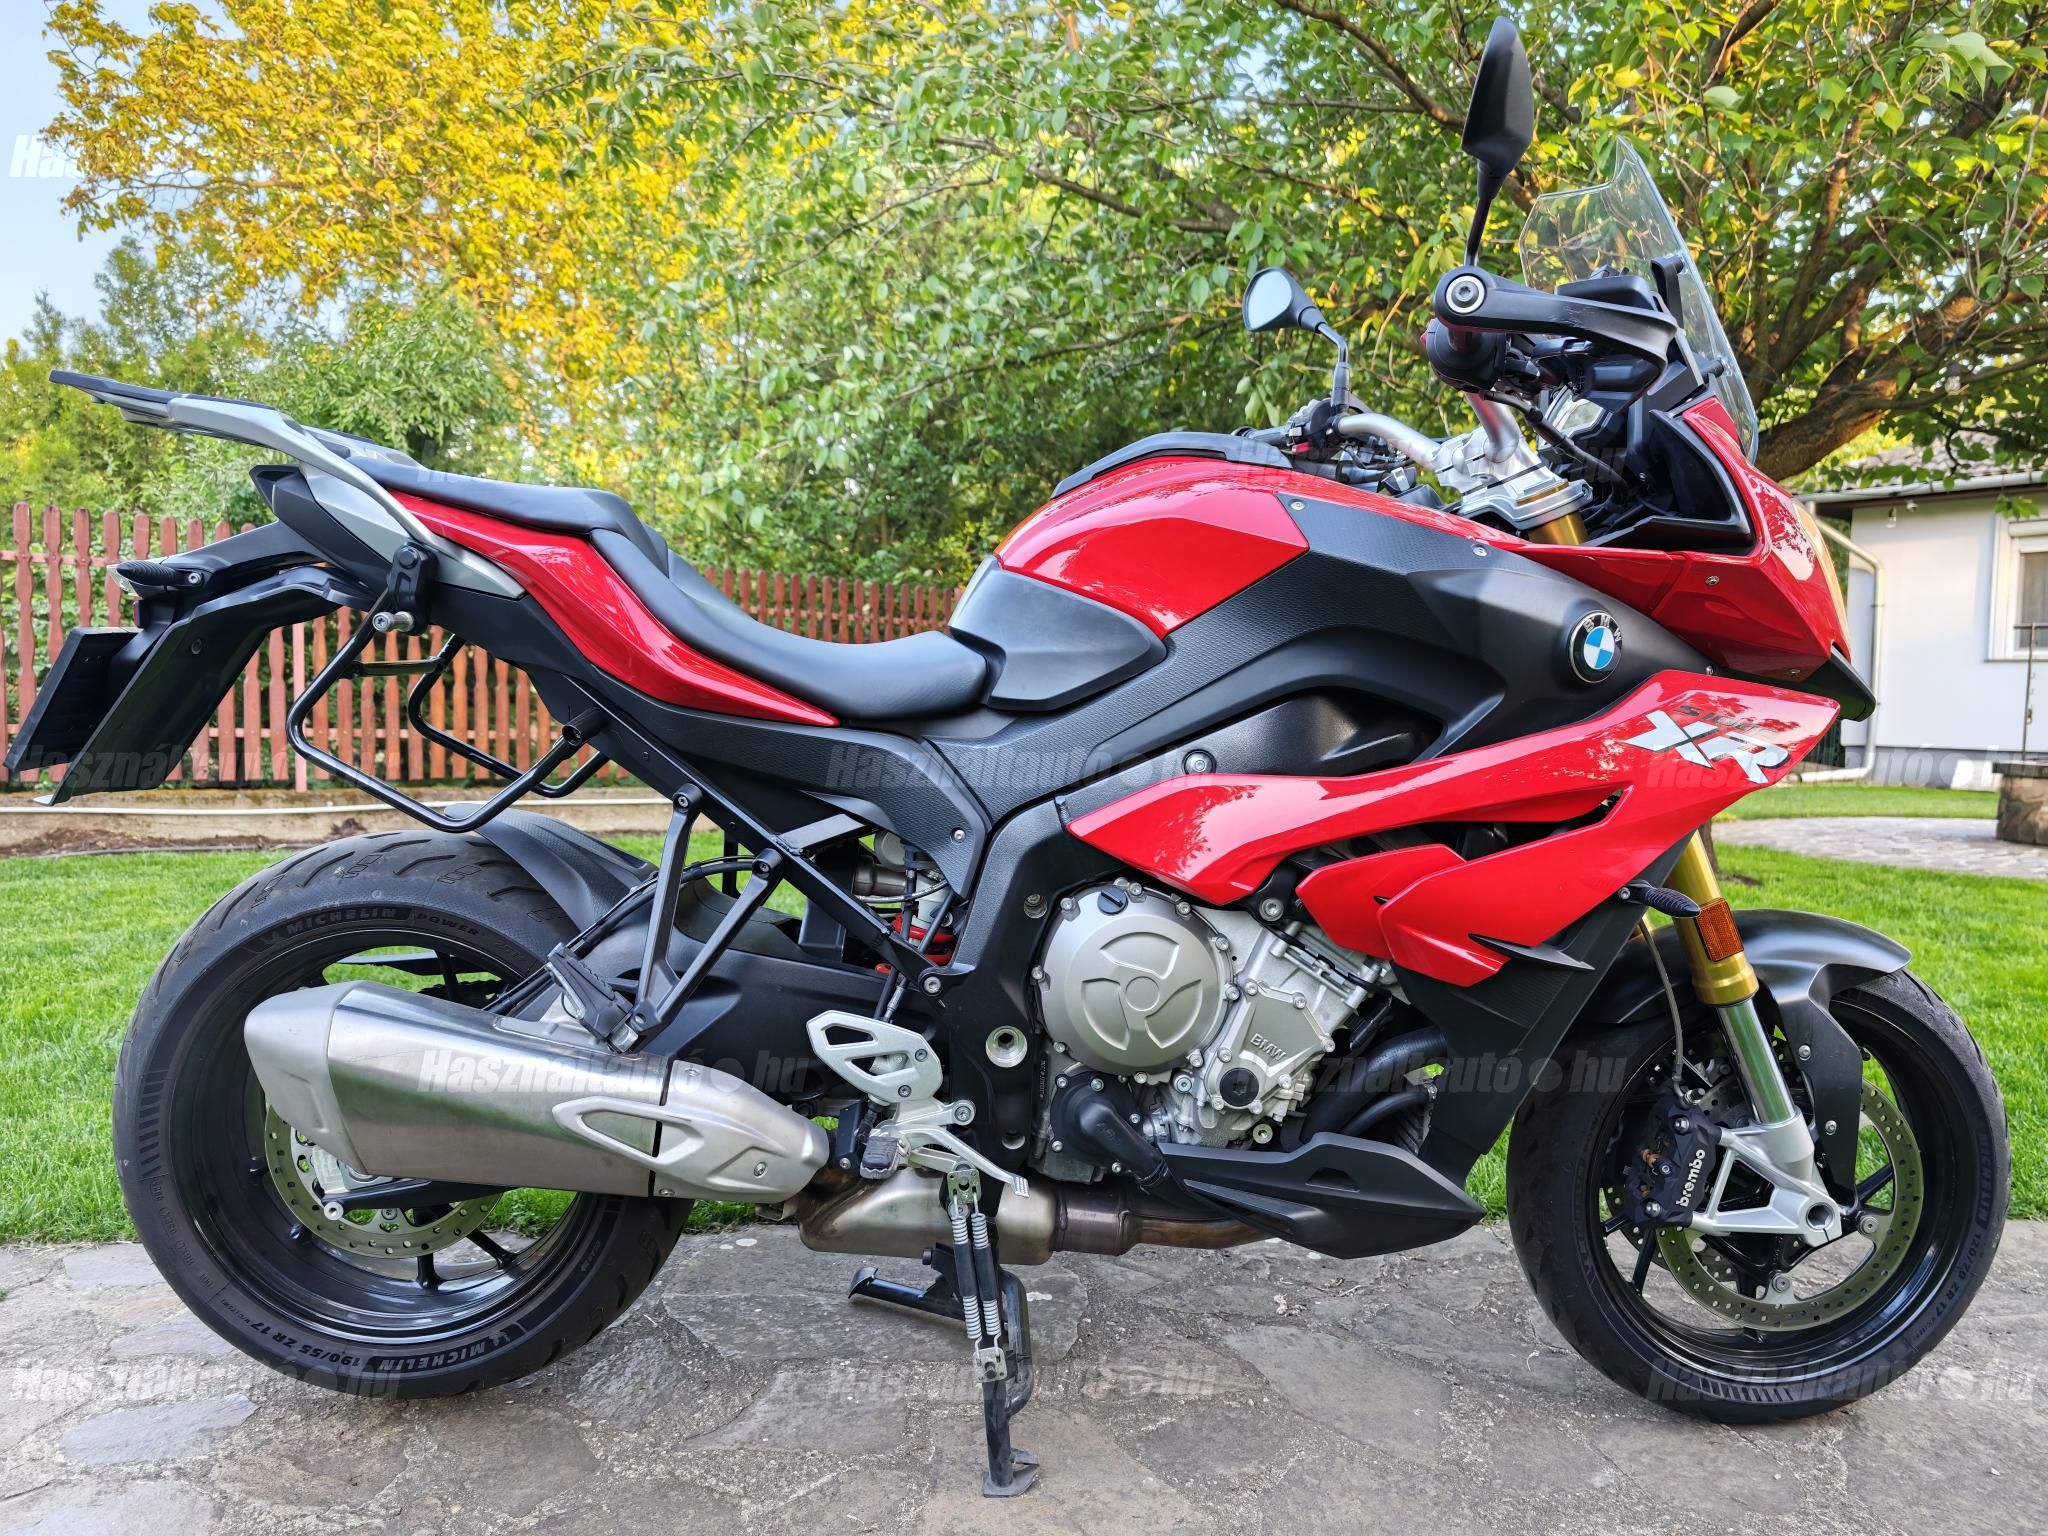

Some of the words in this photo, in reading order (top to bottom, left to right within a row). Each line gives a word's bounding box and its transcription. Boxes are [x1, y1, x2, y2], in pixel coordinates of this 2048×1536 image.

[1582, 614, 1622, 643] BMW
[1622, 709, 1791, 784] XR
[286, 907, 398, 937] MICHELIN
[416, 912, 479, 936] POWER
[1250, 1033, 1287, 1061] BMW
[1676, 1149, 1706, 1207] brembo
[1958, 1231, 1983, 1282] 120/70
[1934, 1301, 1949, 1320] 17
[250, 1321, 271, 1335] 17
[272, 1332, 298, 1349] ZR
[299, 1344, 361, 1367] 190/55
[379, 1343, 486, 1371] MICHELIN
